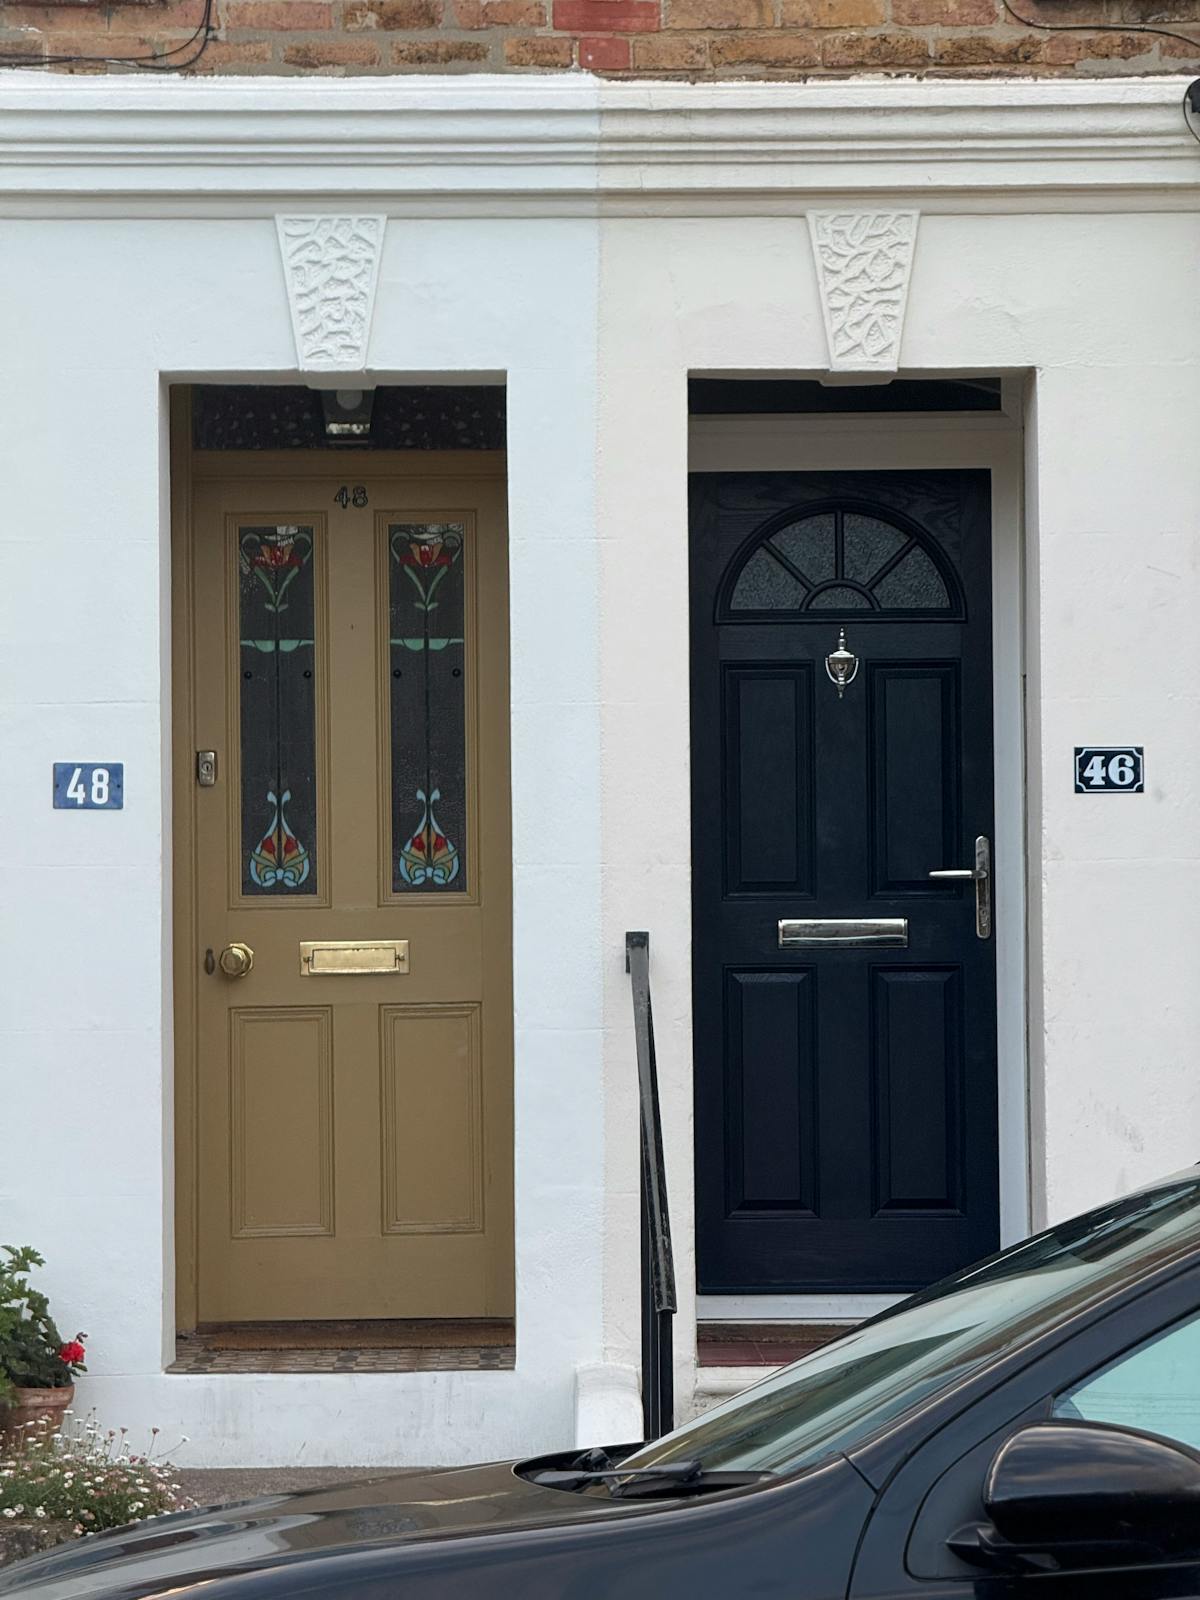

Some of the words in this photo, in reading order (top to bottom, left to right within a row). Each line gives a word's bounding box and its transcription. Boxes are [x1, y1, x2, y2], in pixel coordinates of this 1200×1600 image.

[334, 486, 369, 509] 48
[1083, 754, 1135, 785] 46
[66, 767, 110, 804] 48
